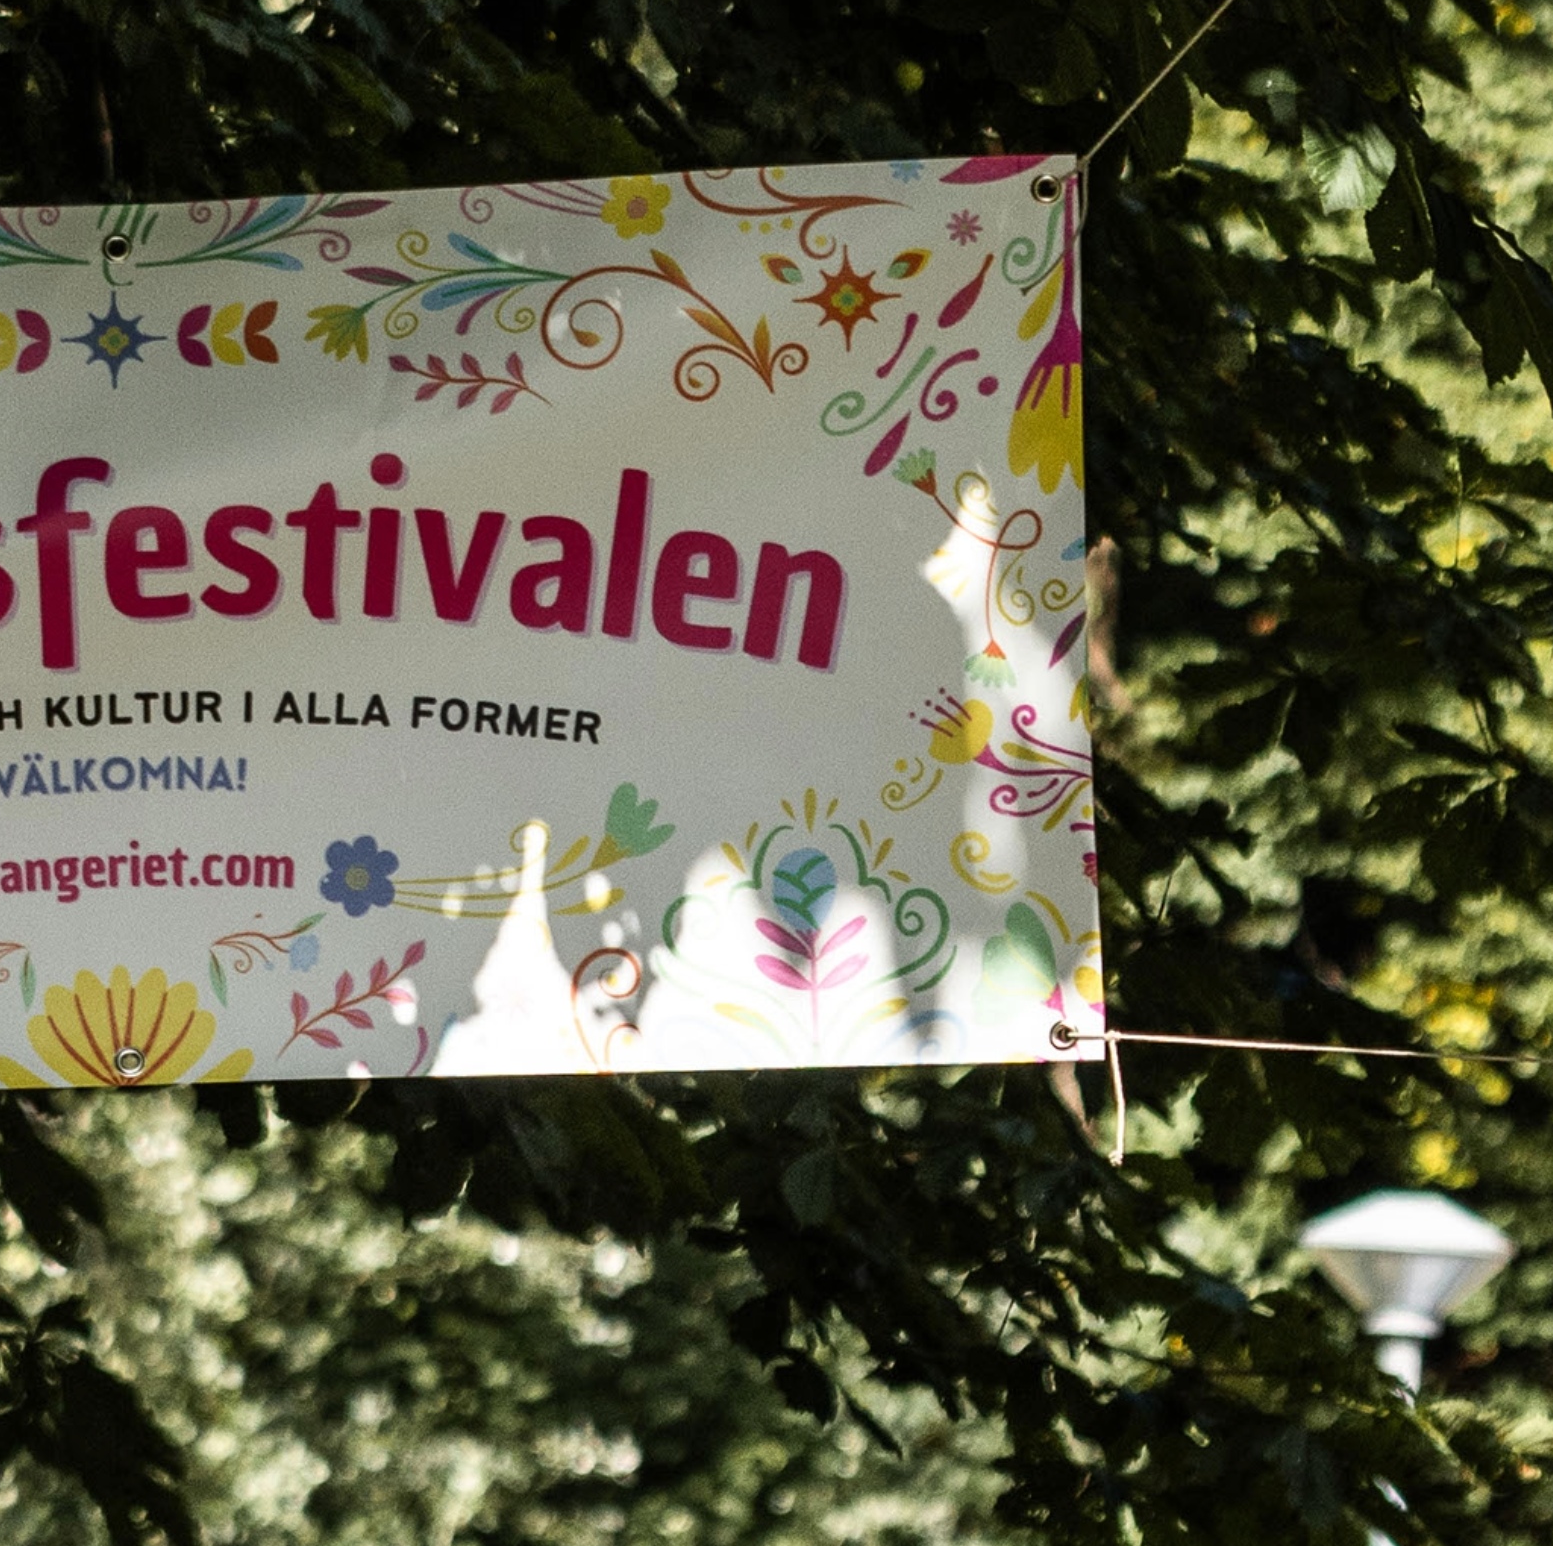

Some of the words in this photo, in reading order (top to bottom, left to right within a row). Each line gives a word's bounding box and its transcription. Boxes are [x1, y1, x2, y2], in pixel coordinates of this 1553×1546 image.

[45, 690, 222, 728] KULTUR
[243, 690, 254, 724] I
[273, 691, 390, 727] ALLA
[411, 696, 602, 745] FORMER
